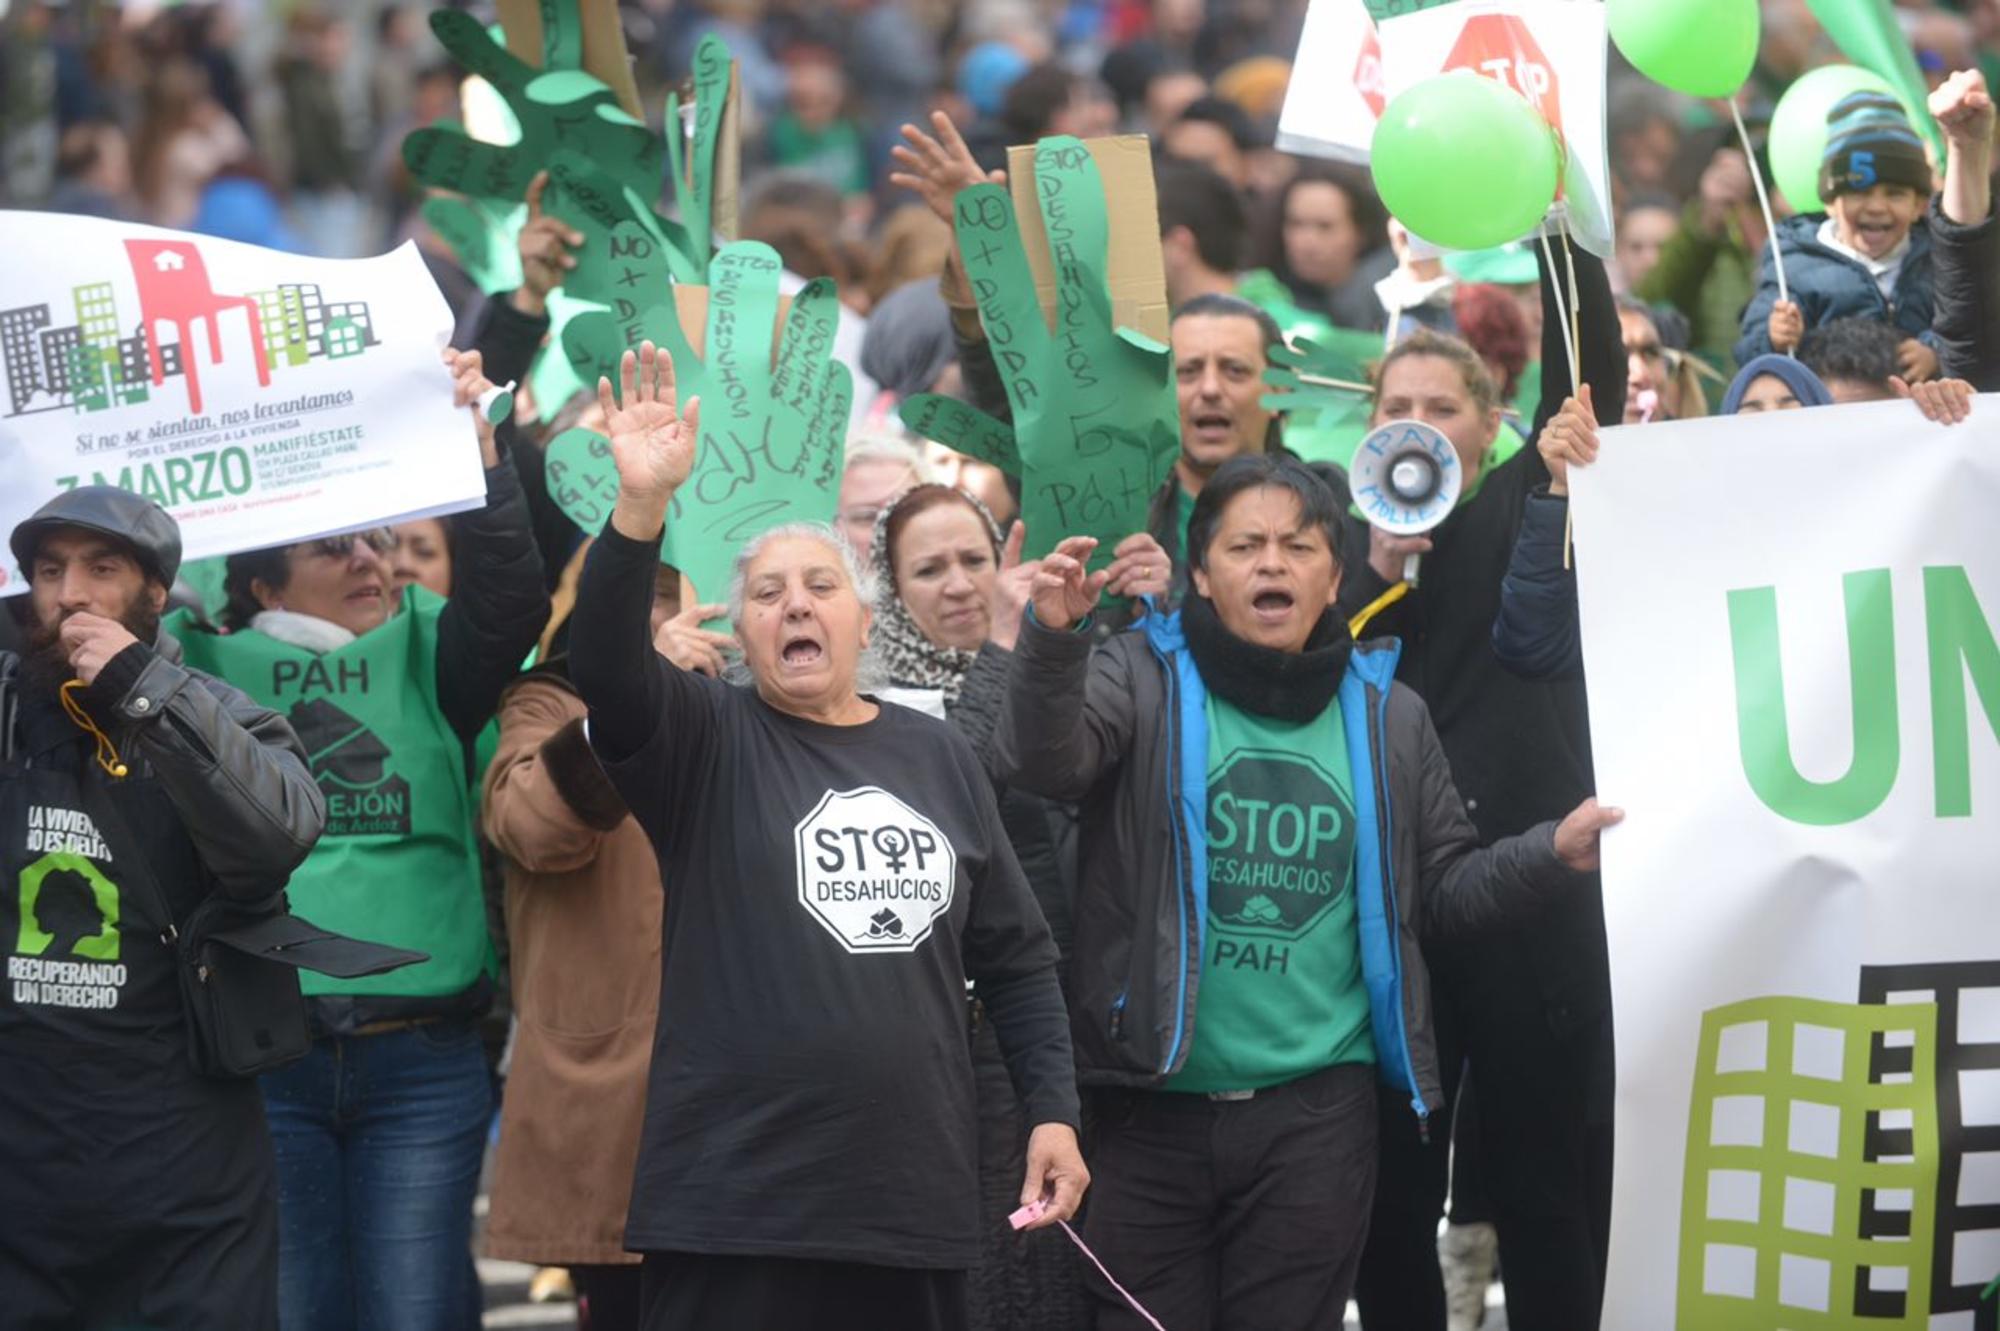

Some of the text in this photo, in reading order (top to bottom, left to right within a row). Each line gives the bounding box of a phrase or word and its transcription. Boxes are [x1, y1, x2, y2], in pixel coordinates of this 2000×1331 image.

[1036, 148, 1090, 173] STOP
[1850, 151, 1877, 191] 5
[959, 195, 1009, 231] NO
[609, 235, 652, 260] NO
[717, 253, 779, 274] STOP
[1041, 176, 1098, 389] DESAHUCIOS
[974, 277, 1038, 409] DEUDA
[75, 389, 354, 452] Si no se sientan, nos levantamos
[169, 435, 222, 452] DERECHO
[250, 418, 301, 437] VIVIENDA
[1070, 395, 1120, 458] 5
[253, 424, 364, 457] MANIFIÉSTATE
[1366, 428, 1454, 468] PAH
[1039, 455, 1156, 529] PAH
[1359, 485, 1448, 525] MOLLET
[273, 657, 370, 696] PAH
[28, 805, 44, 829] LA
[1207, 791, 1342, 860] STOP
[43, 830, 65, 853] ES
[815, 824, 937, 875] STOP
[816, 878, 942, 902] DESAHUCIOS
[1207, 856, 1333, 896] ESAHUCIOS
[8, 956, 128, 987] RECUPERANDO
[1212, 940, 1290, 975] PAH
[13, 980, 119, 1010] UN DERECHO
